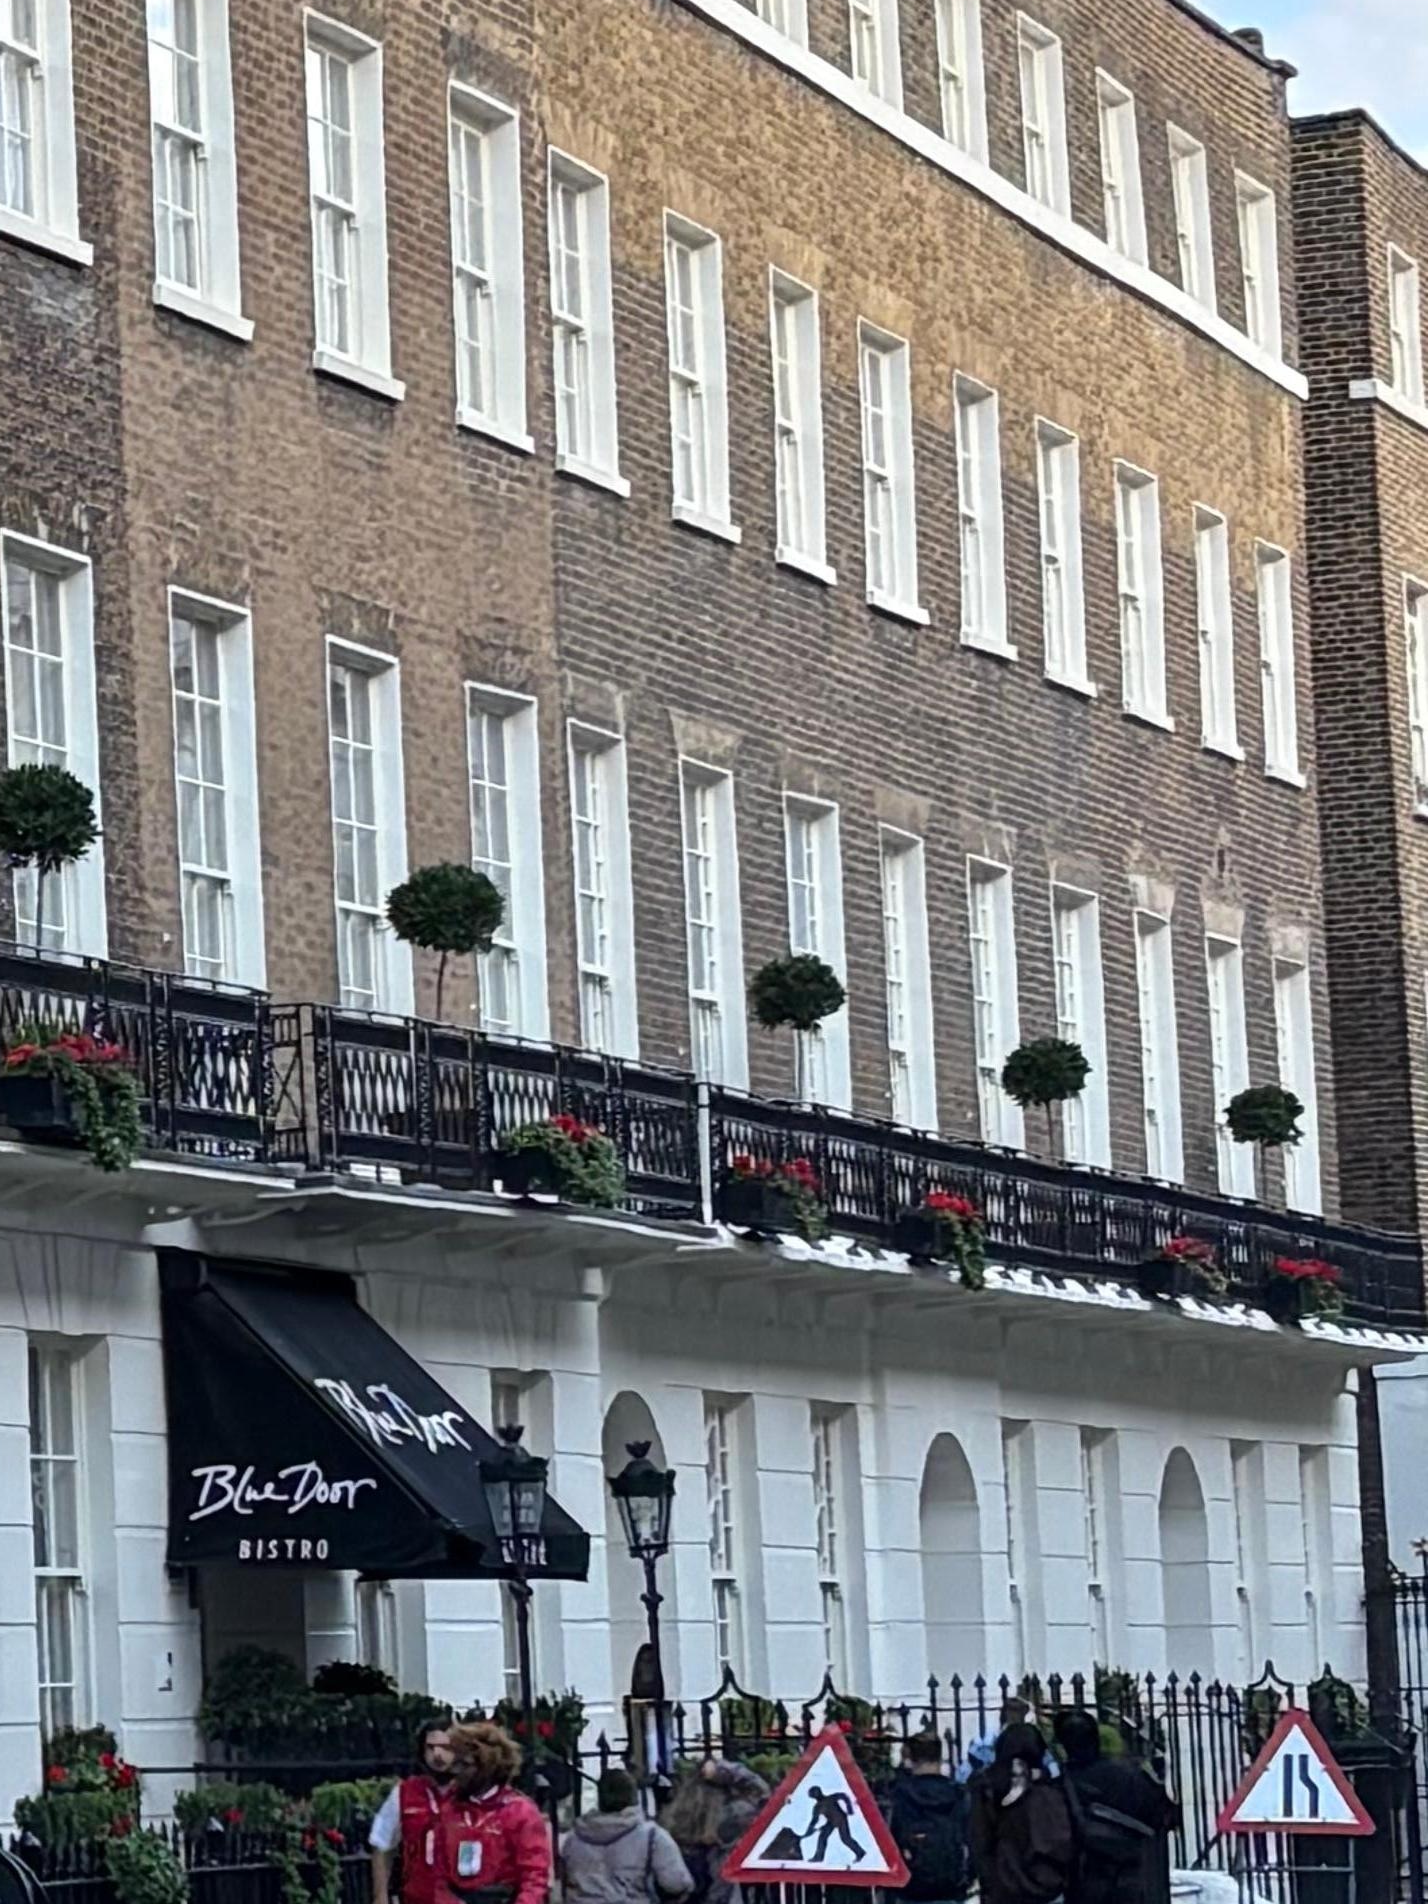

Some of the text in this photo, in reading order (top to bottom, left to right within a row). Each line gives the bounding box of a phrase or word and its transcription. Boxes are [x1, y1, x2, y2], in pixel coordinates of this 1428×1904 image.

[314, 1377, 472, 1454] Blue Door
[189, 1460, 378, 1521] Blue Door
[239, 1538, 330, 1560] BISTRO
